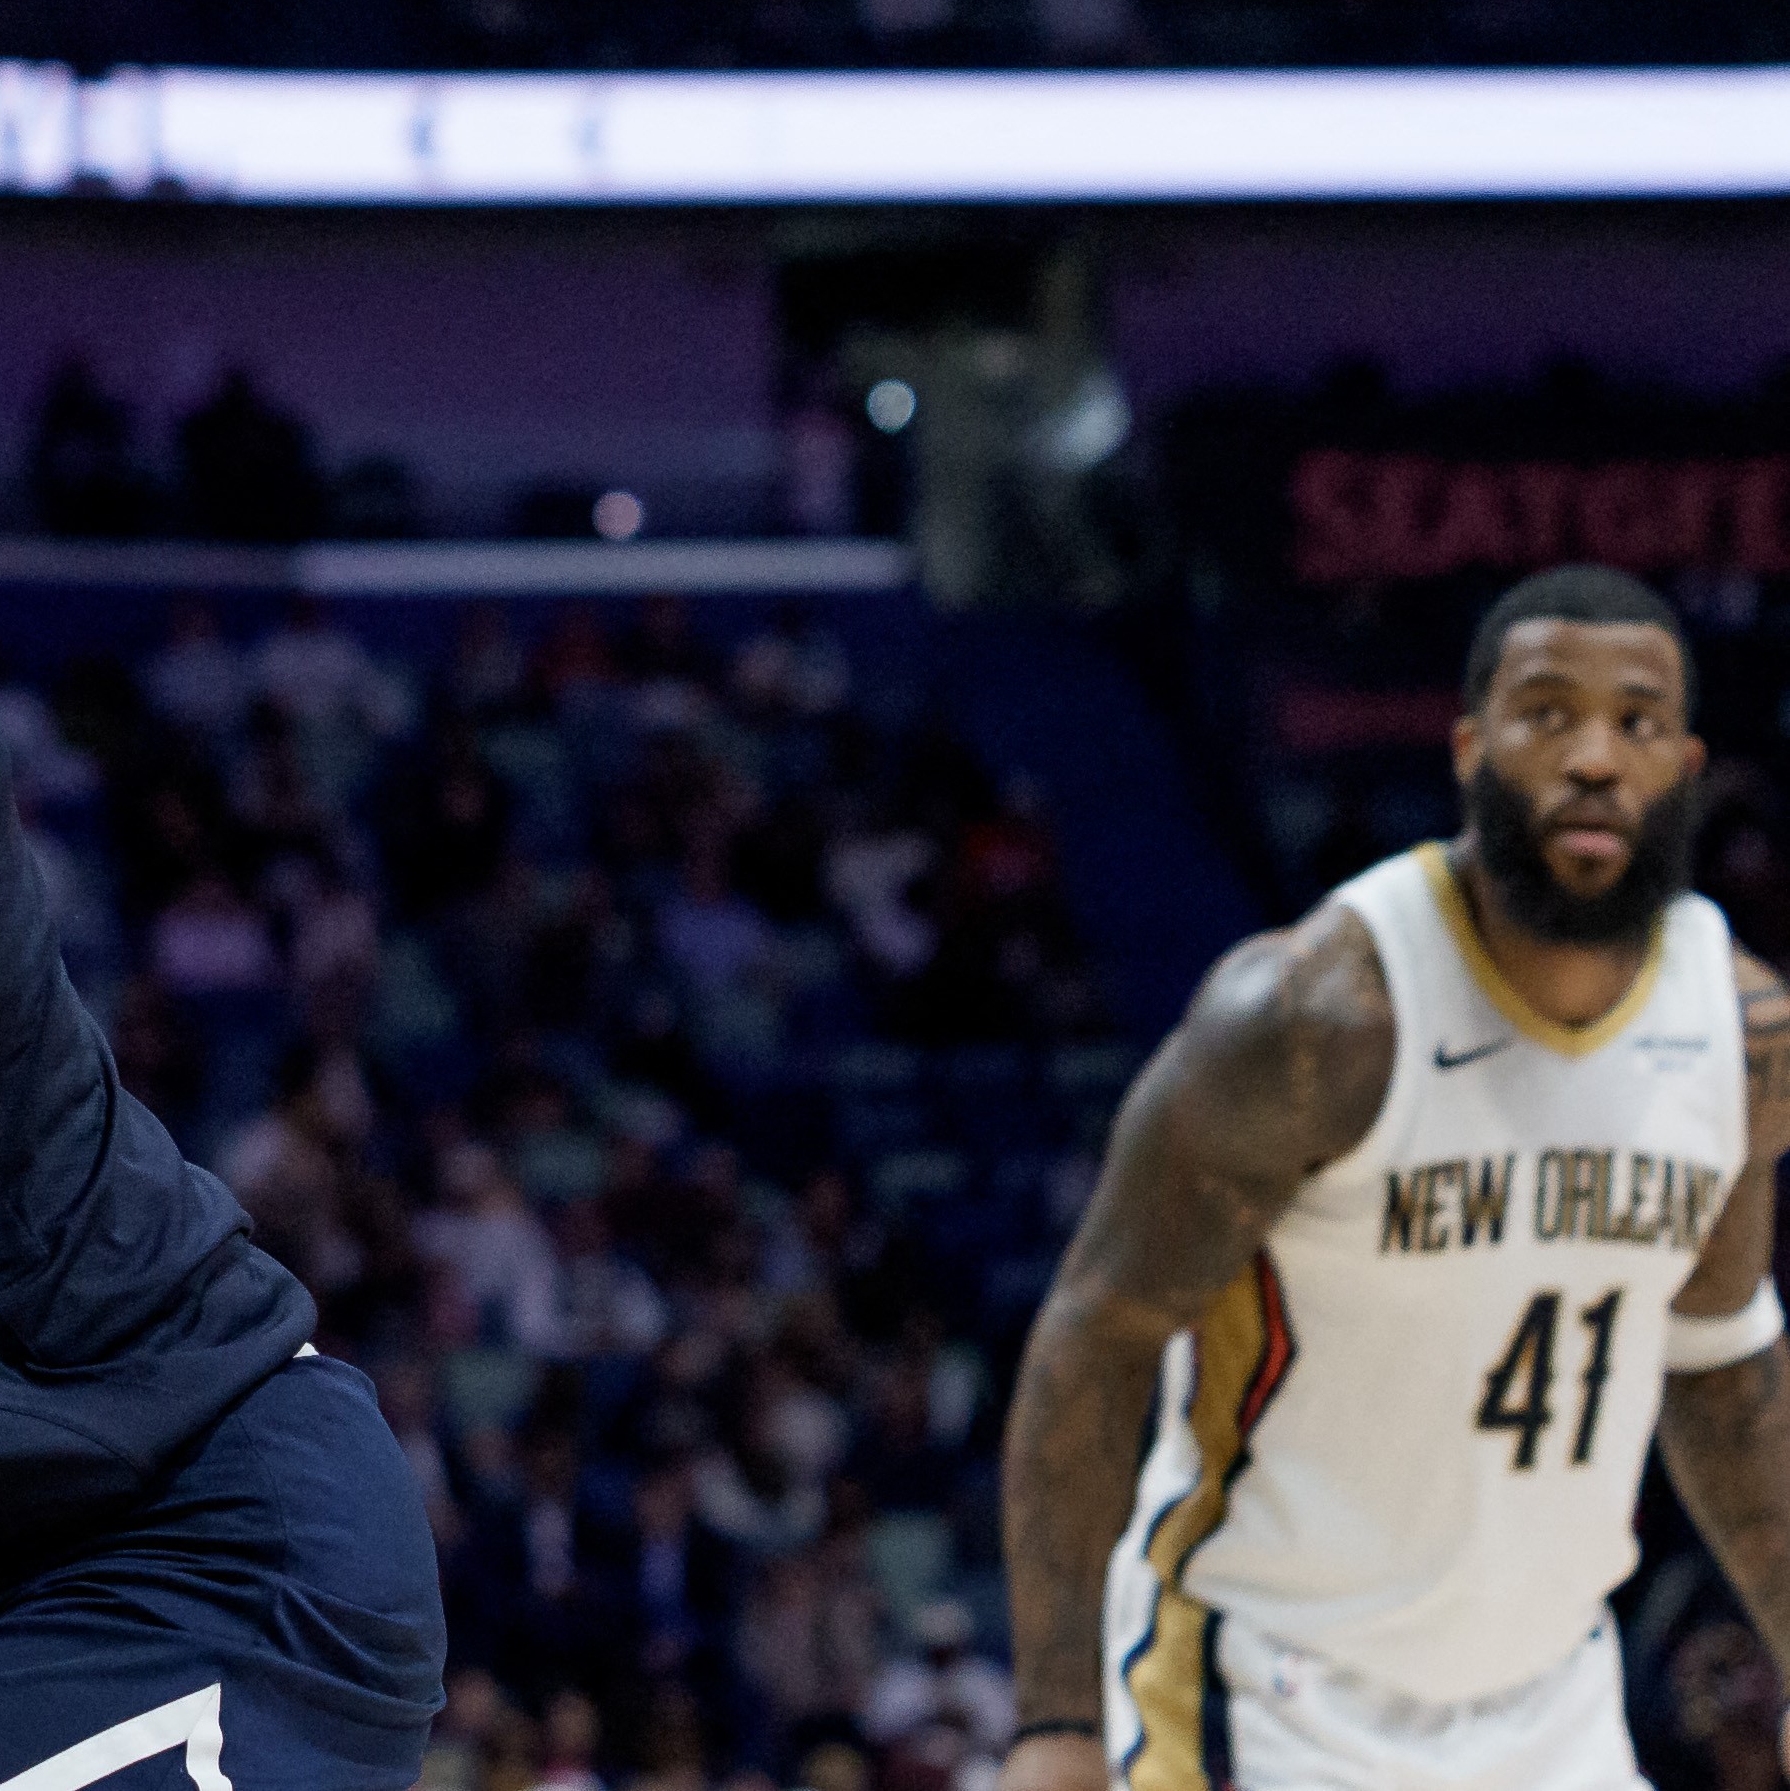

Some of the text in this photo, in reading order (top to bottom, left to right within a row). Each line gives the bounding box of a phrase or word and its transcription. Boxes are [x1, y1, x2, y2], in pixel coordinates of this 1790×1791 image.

[1379, 1145, 1723, 1255] NEW ORLEAN
[1475, 1281, 1626, 1472] 41
